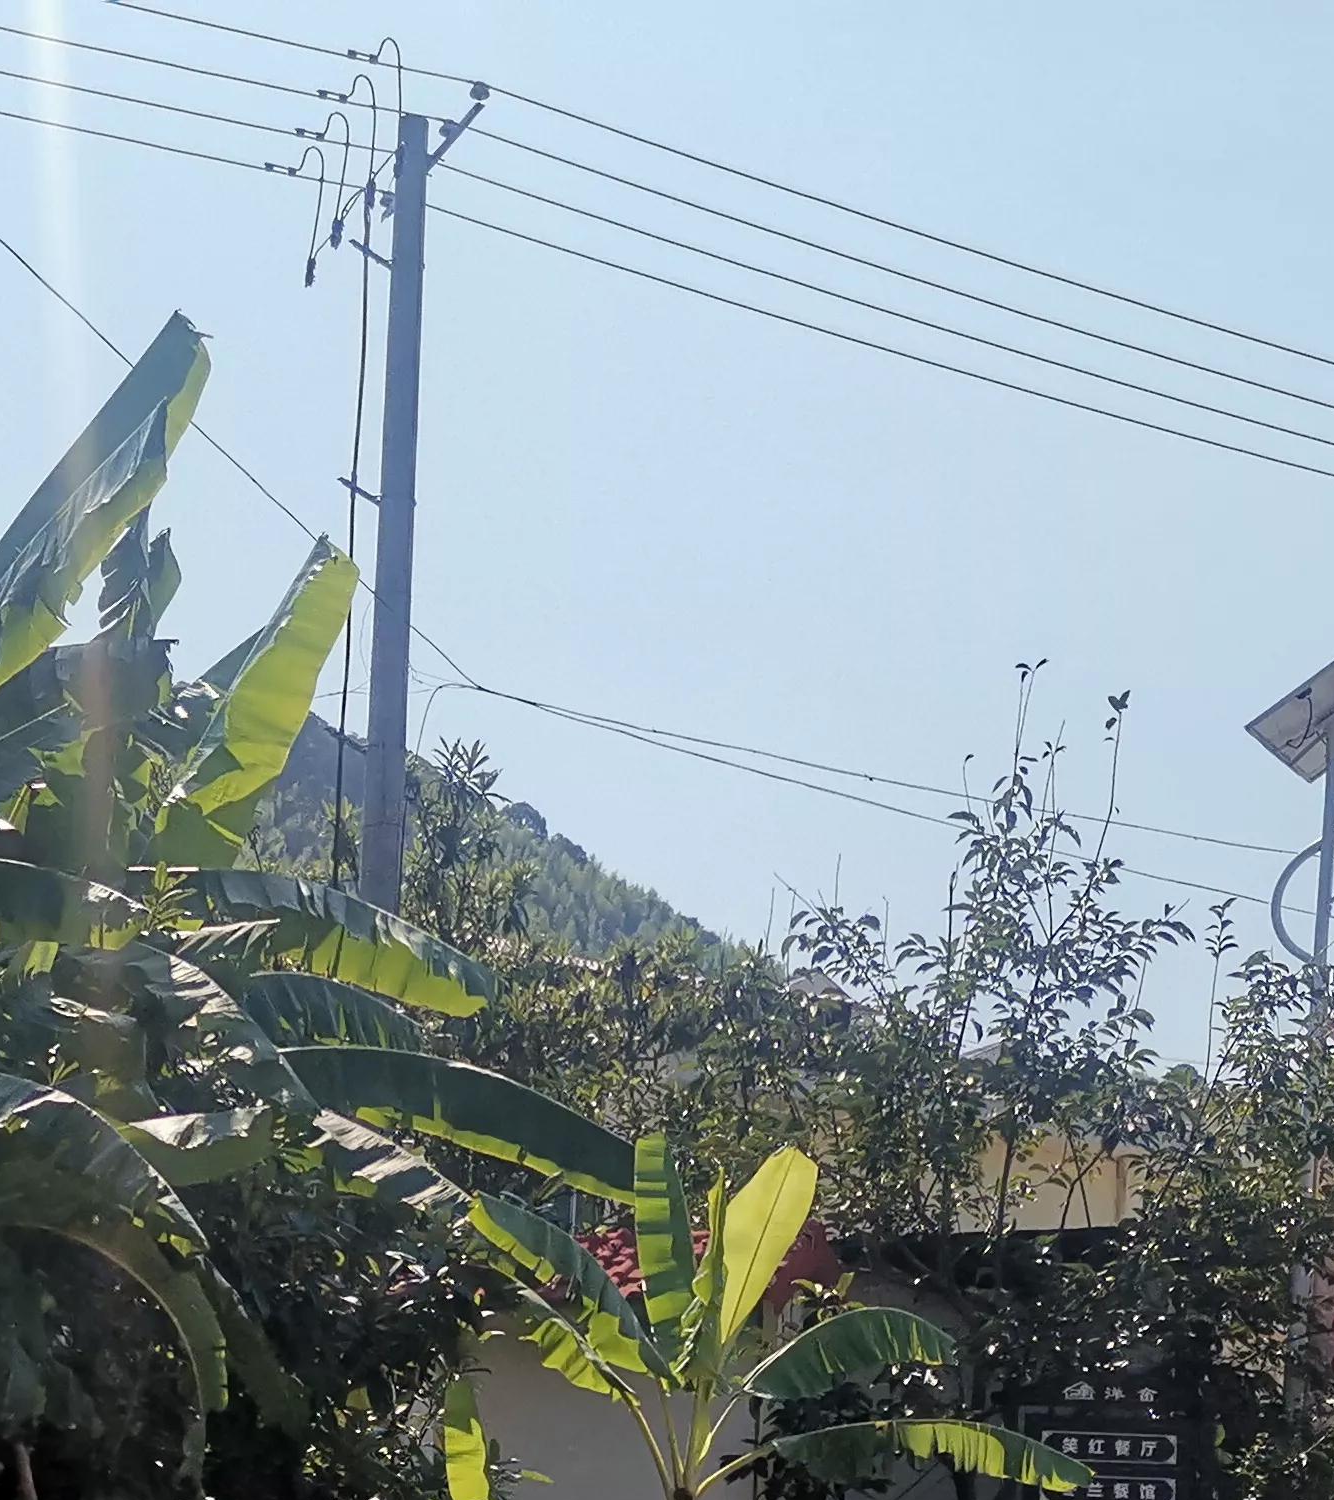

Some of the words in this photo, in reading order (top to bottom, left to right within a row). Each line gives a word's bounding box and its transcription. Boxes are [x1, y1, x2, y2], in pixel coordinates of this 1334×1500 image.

[1061, 1437, 1158, 1457] 笑红餐厅
[1061, 1481, 1157, 1500] 兰餐馆
